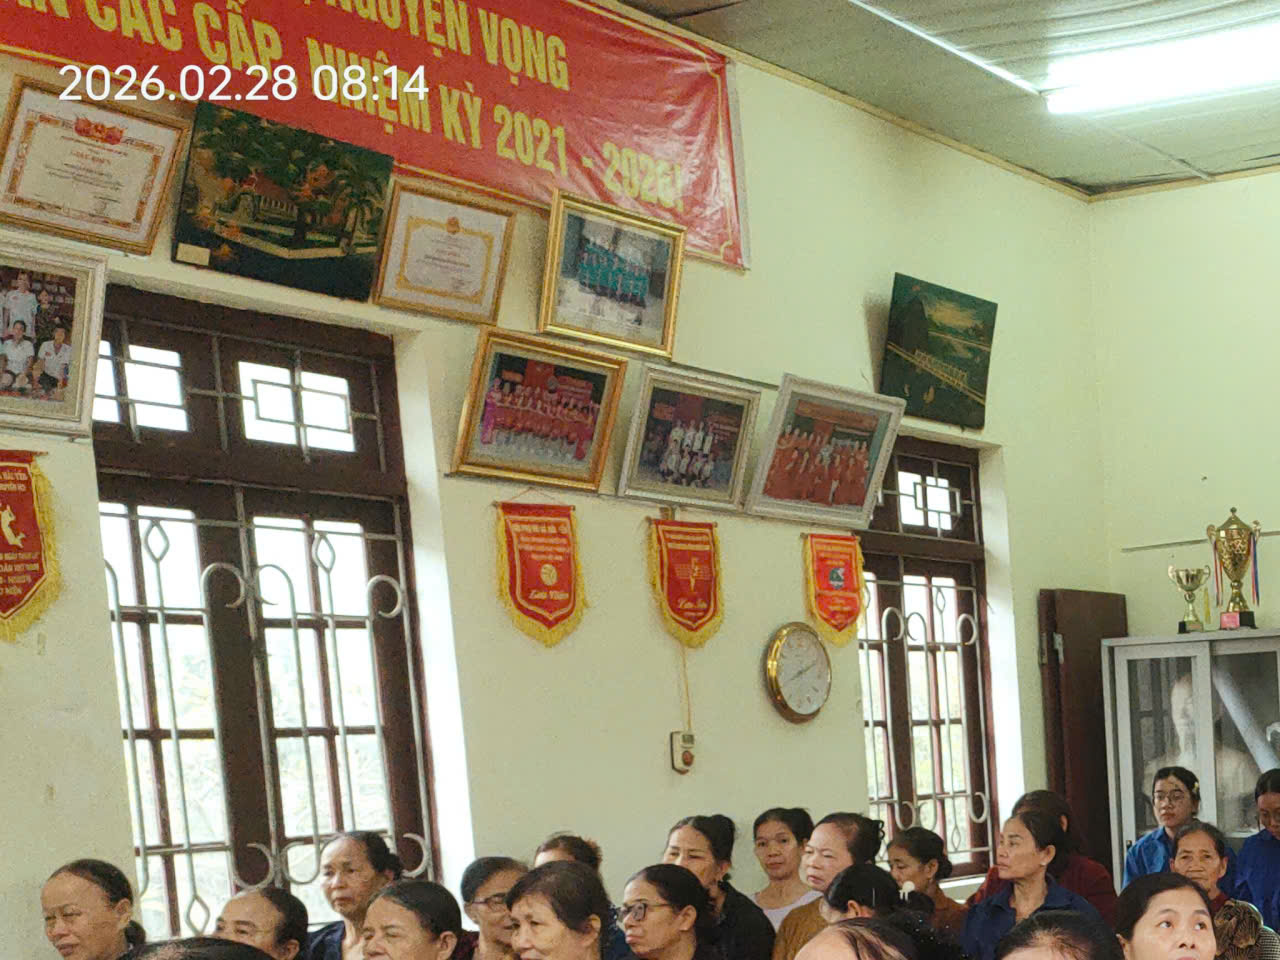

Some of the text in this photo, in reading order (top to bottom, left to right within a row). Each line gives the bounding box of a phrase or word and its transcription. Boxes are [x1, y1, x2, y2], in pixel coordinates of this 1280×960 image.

[478, 7, 569, 91] VỌNG
[306, 37, 432, 135] NHIỆM
[439, 81, 482, 149] KỲ
[493, 104, 568, 177] 2021
